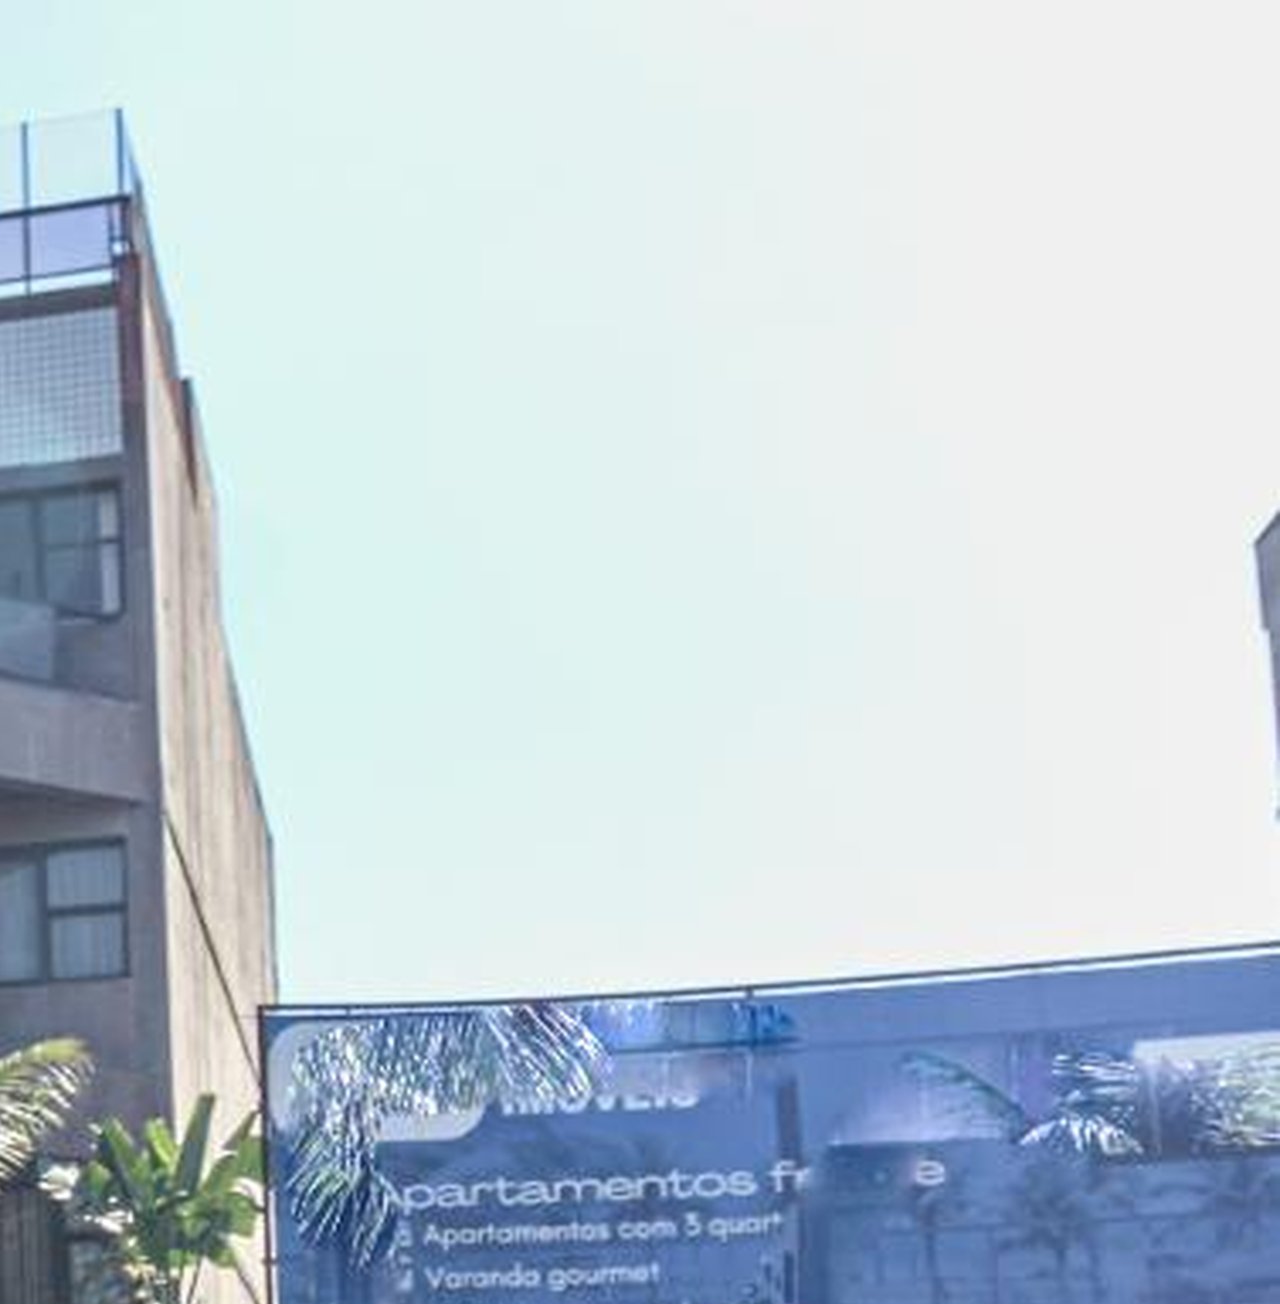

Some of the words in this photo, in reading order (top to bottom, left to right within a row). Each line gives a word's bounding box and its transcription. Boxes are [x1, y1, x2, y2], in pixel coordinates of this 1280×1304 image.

[423, 1217, 610, 1249] Apartamentos
[617, 1217, 676, 1240] com
[683, 1211, 702, 1238] 3
[425, 1263, 540, 1291] Varanda
[547, 1262, 660, 1293] gourmet
